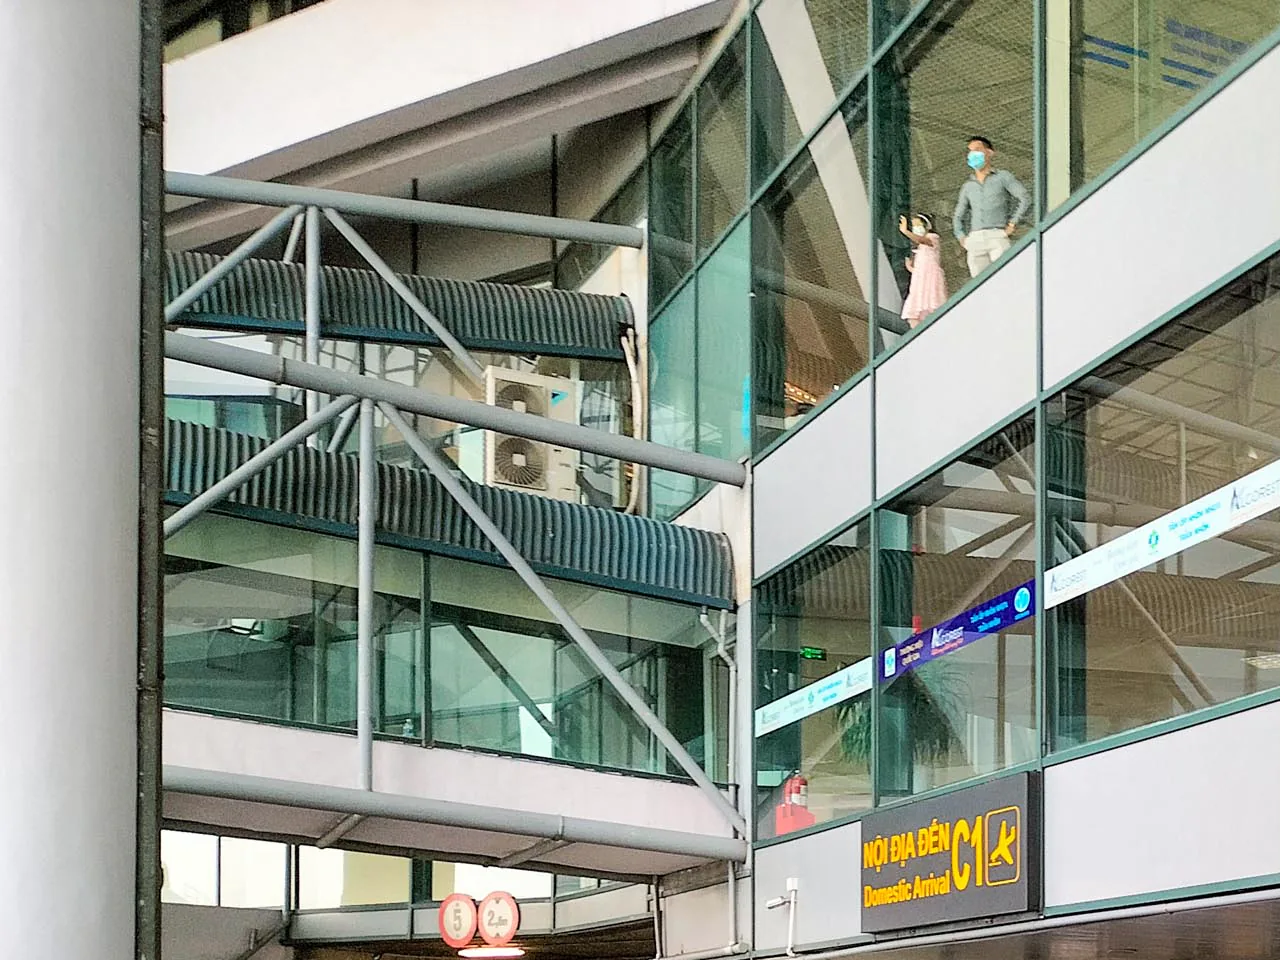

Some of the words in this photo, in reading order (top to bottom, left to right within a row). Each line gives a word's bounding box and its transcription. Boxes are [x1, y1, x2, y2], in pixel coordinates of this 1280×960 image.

[863, 834, 888, 873] NỘI
[890, 831, 916, 867] ĐỊA
[917, 818, 950, 857] ĐẾN
[951, 815, 983, 891] C1
[863, 878, 912, 908] Domestic
[913, 869, 950, 899] Arrival
[453, 908, 463, 932] 5
